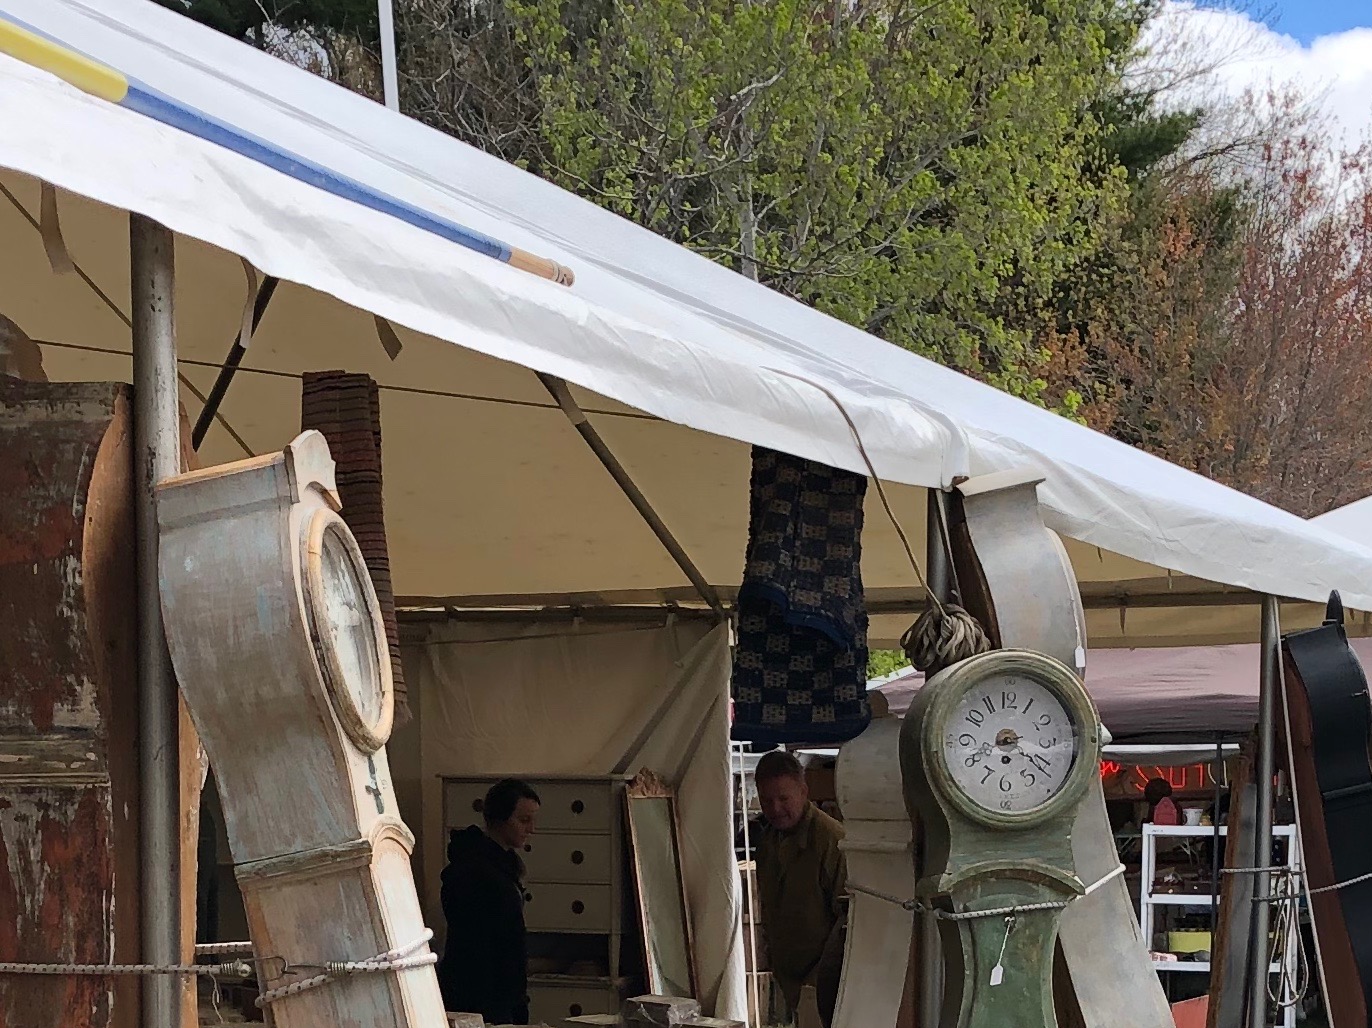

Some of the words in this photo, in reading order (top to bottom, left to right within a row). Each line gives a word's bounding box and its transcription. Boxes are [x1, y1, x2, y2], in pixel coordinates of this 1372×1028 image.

[982, 696, 996, 714] 11
[1002, 692, 1017, 709] 12
[1022, 698, 1034, 714] 1
[965, 709, 984, 728] 10
[1032, 714, 1051, 731] 2
[958, 734, 977, 746] 9
[1039, 737, 1056, 749] 3
[965, 752, 981, 767] 8
[1034, 754, 1051, 774] 4
[981, 765, 995, 784] 7
[1000, 775, 1012, 791] 6
[1020, 769, 1035, 787] 5
